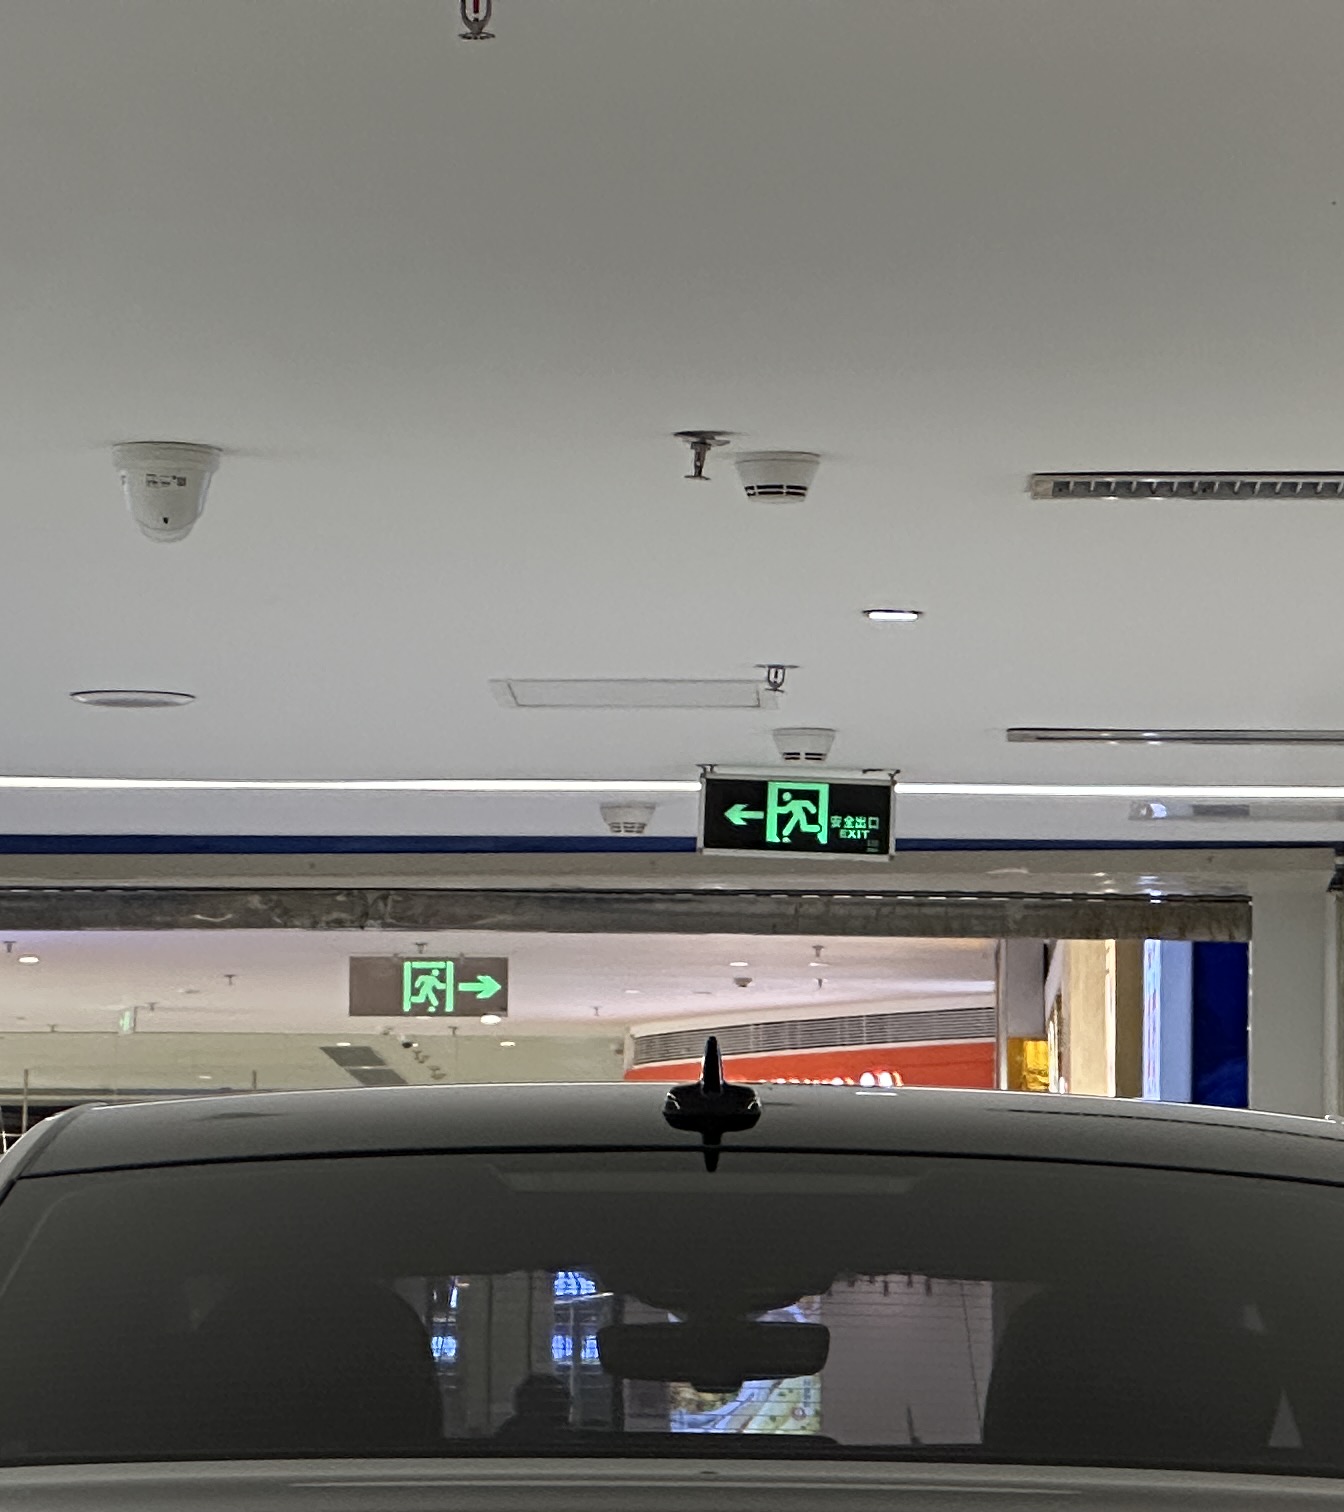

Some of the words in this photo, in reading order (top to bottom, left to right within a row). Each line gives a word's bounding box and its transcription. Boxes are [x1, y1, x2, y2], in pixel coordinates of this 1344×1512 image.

[830, 815, 879, 829] 安全出口
[839, 829, 870, 839] EXIT
